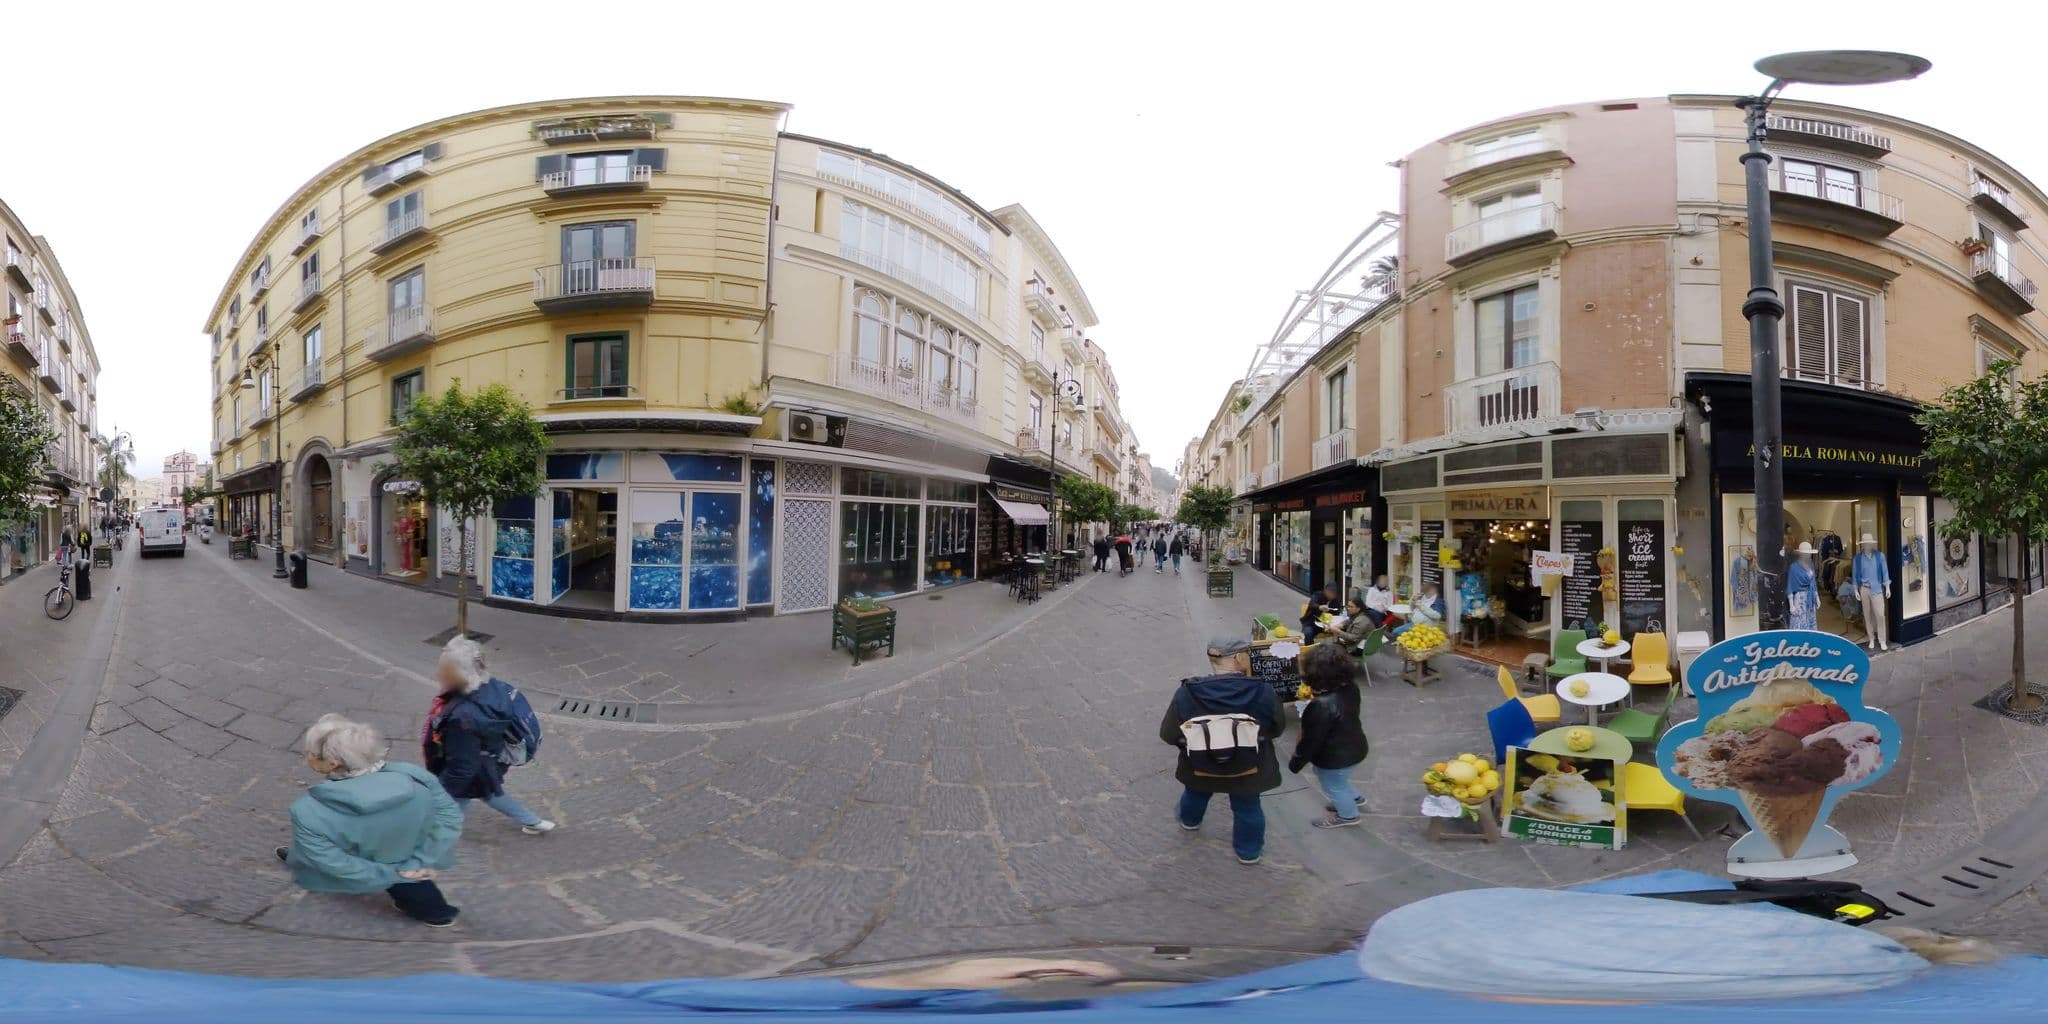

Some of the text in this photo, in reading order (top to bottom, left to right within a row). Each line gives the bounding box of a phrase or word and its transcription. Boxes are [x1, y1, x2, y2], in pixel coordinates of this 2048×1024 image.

[1747, 444, 1922, 468] AELA ROMANO AMALFI
[1450, 497, 1537, 512] PRIMAVERA
[1631, 544, 1652, 554] ice
[1628, 554, 1656, 562] cream
[1743, 639, 1821, 666] Gelato
[1703, 661, 1859, 693] Artigianale
[1528, 828, 1592, 840] SORRENTO
[1538, 823, 1580, 834] DOLCE
